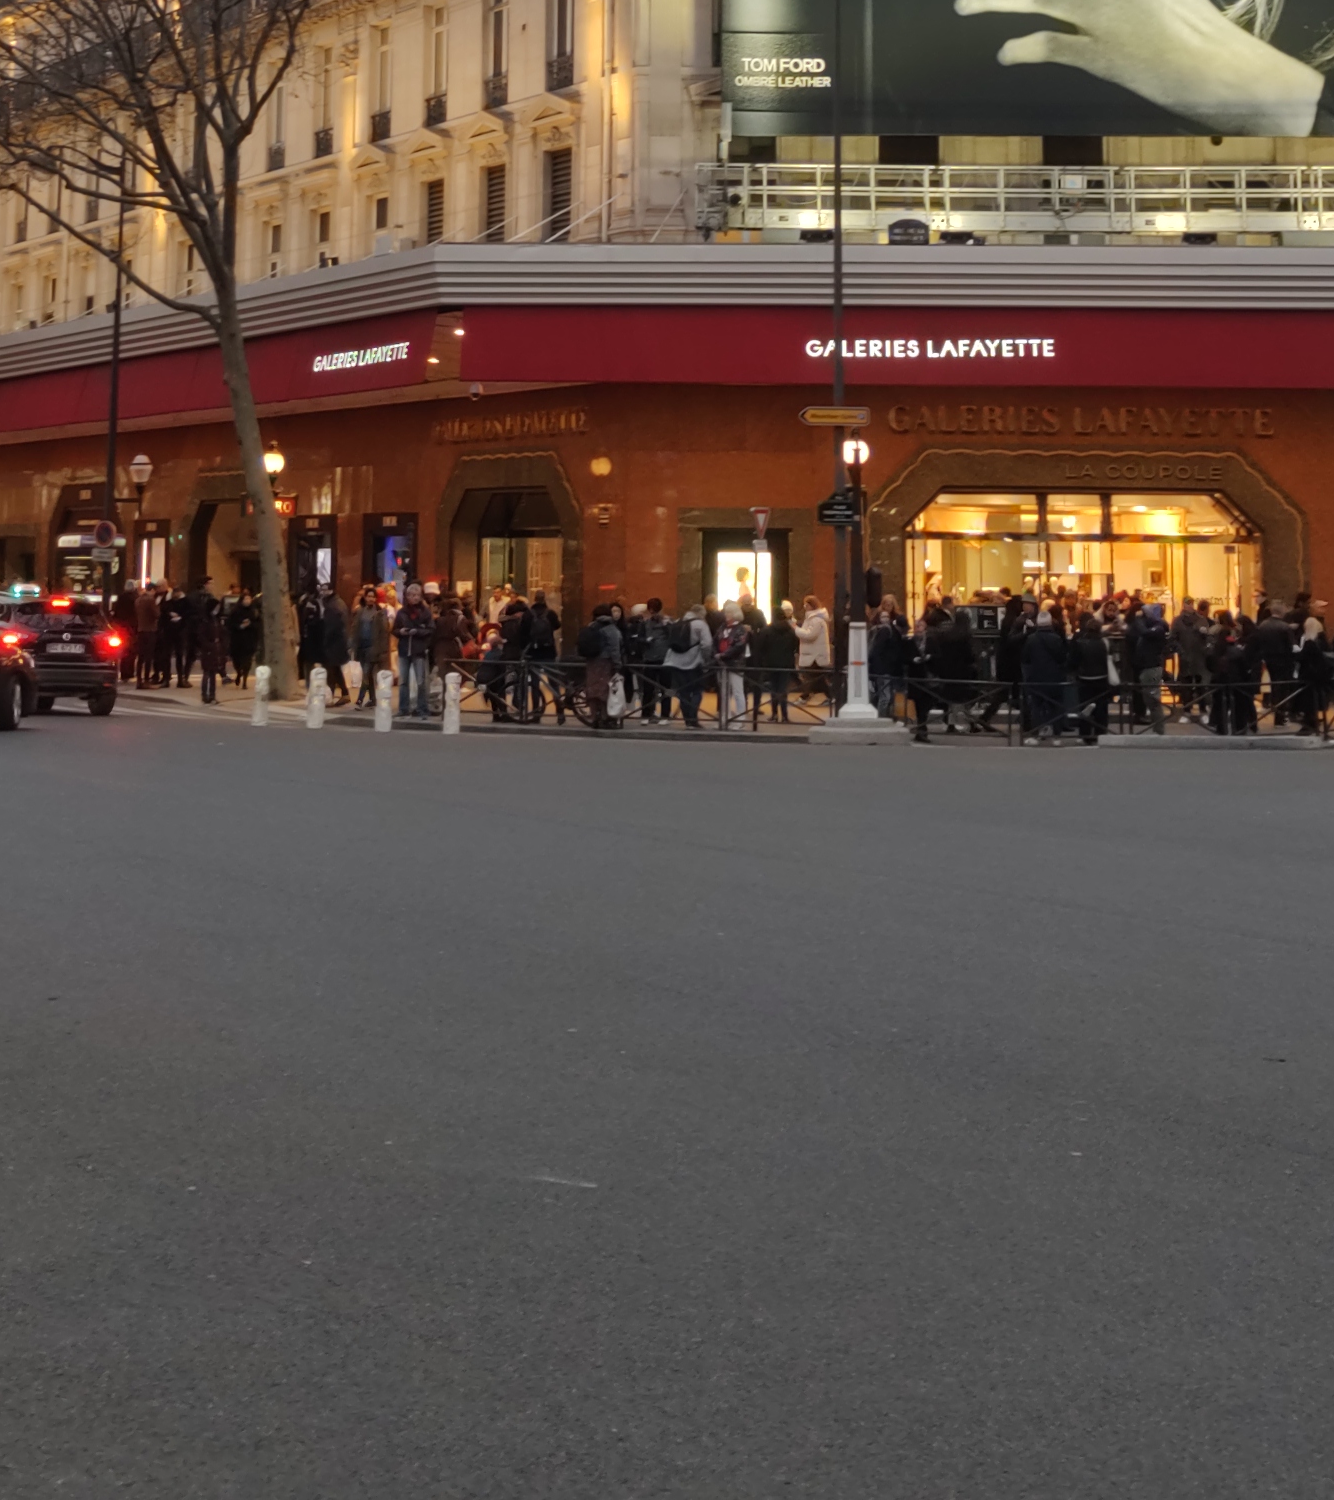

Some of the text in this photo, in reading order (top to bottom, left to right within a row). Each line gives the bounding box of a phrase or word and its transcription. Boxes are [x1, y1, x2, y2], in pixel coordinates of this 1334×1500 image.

[741, 57, 826, 73] TOM FORD
[734, 74, 831, 88] OMBRÉ LEATHER
[313, 342, 410, 372] GALERIES LAFAYETTE
[926, 338, 1056, 358] LAFAYETTE
[887, 404, 1275, 438] GALERIES LAFAYETTE
[1065, 464, 1223, 481] LA COUPOLE
